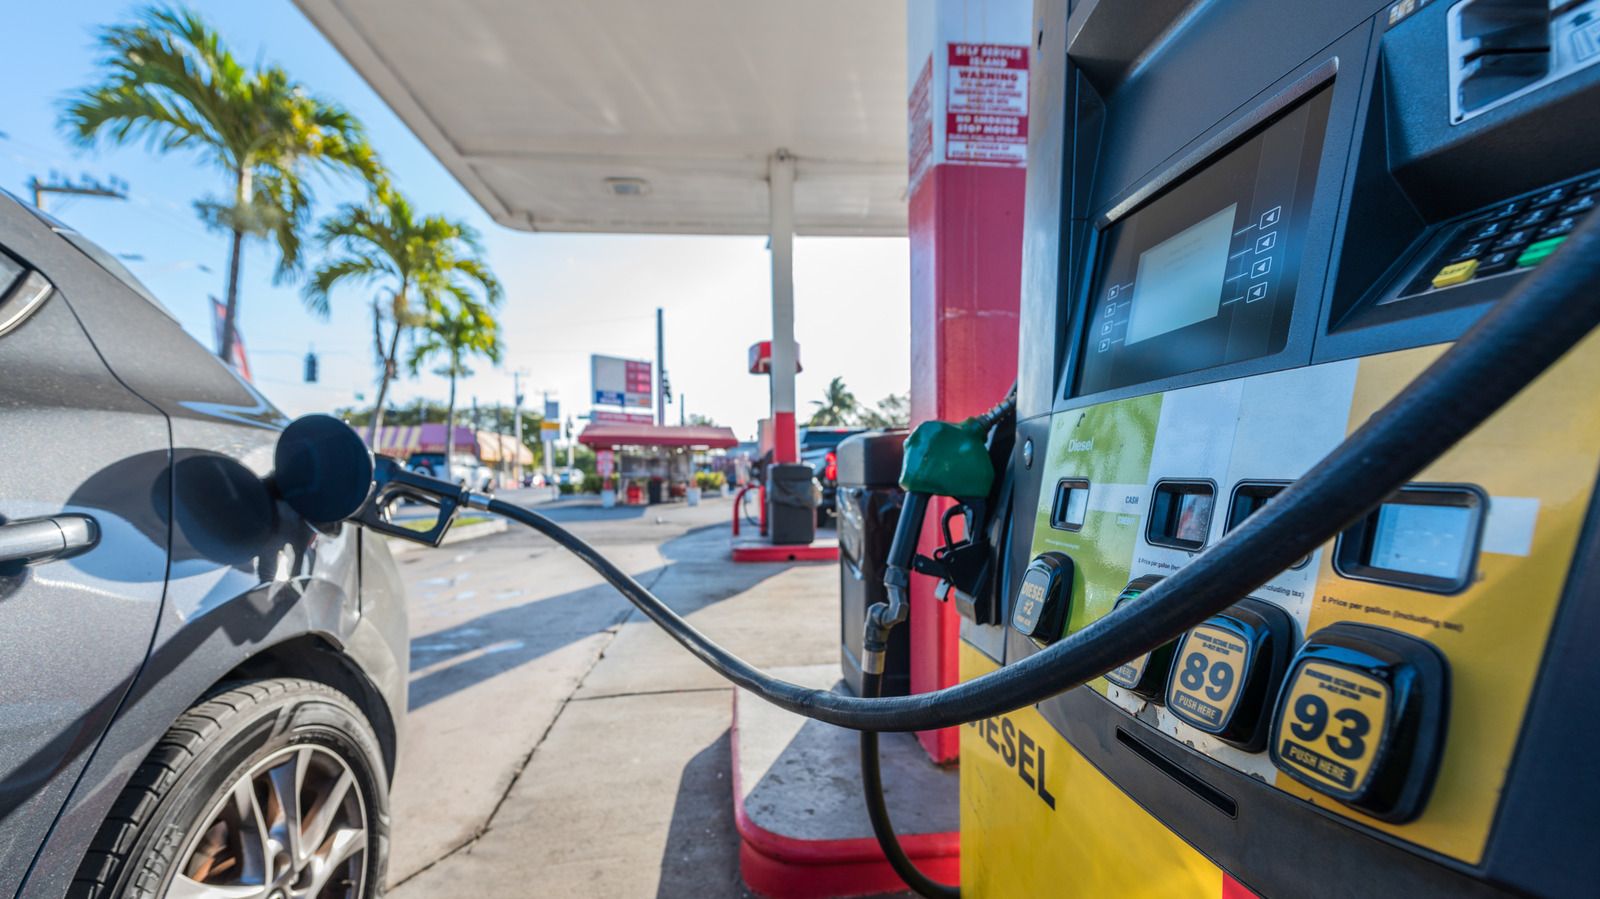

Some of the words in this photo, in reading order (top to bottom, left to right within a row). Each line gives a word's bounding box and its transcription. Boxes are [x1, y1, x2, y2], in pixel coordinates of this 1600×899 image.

[956, 45, 979, 56] SELF
[981, 46, 1022, 59] SERVICE
[969, 56, 1008, 68] ISLAND
[958, 71, 1018, 82] WARNING
[956, 115, 971, 124] NO
[973, 115, 1019, 126] SMOKING
[957, 124, 982, 134] STOP
[983, 125, 1019, 136] MOTOR
[1068, 437, 1095, 453] Diesel
[1125, 496, 1139, 505] CASH
[1021, 581, 1045, 603] DIESEL
[1023, 600, 1035, 616] #2
[1328, 595, 1348, 607] Price
[1349, 602, 1363, 610] per
[1364, 604, 1392, 616] gallon
[1180, 652, 1234, 702] 89
[1178, 694, 1197, 710] PUSH
[1197, 703, 1217, 720] HERE
[1290, 694, 1371, 761] 93
[968, 716, 1056, 812] ESEL
[1289, 745, 1318, 768] PUSH
[1317, 759, 1349, 782] HERE
